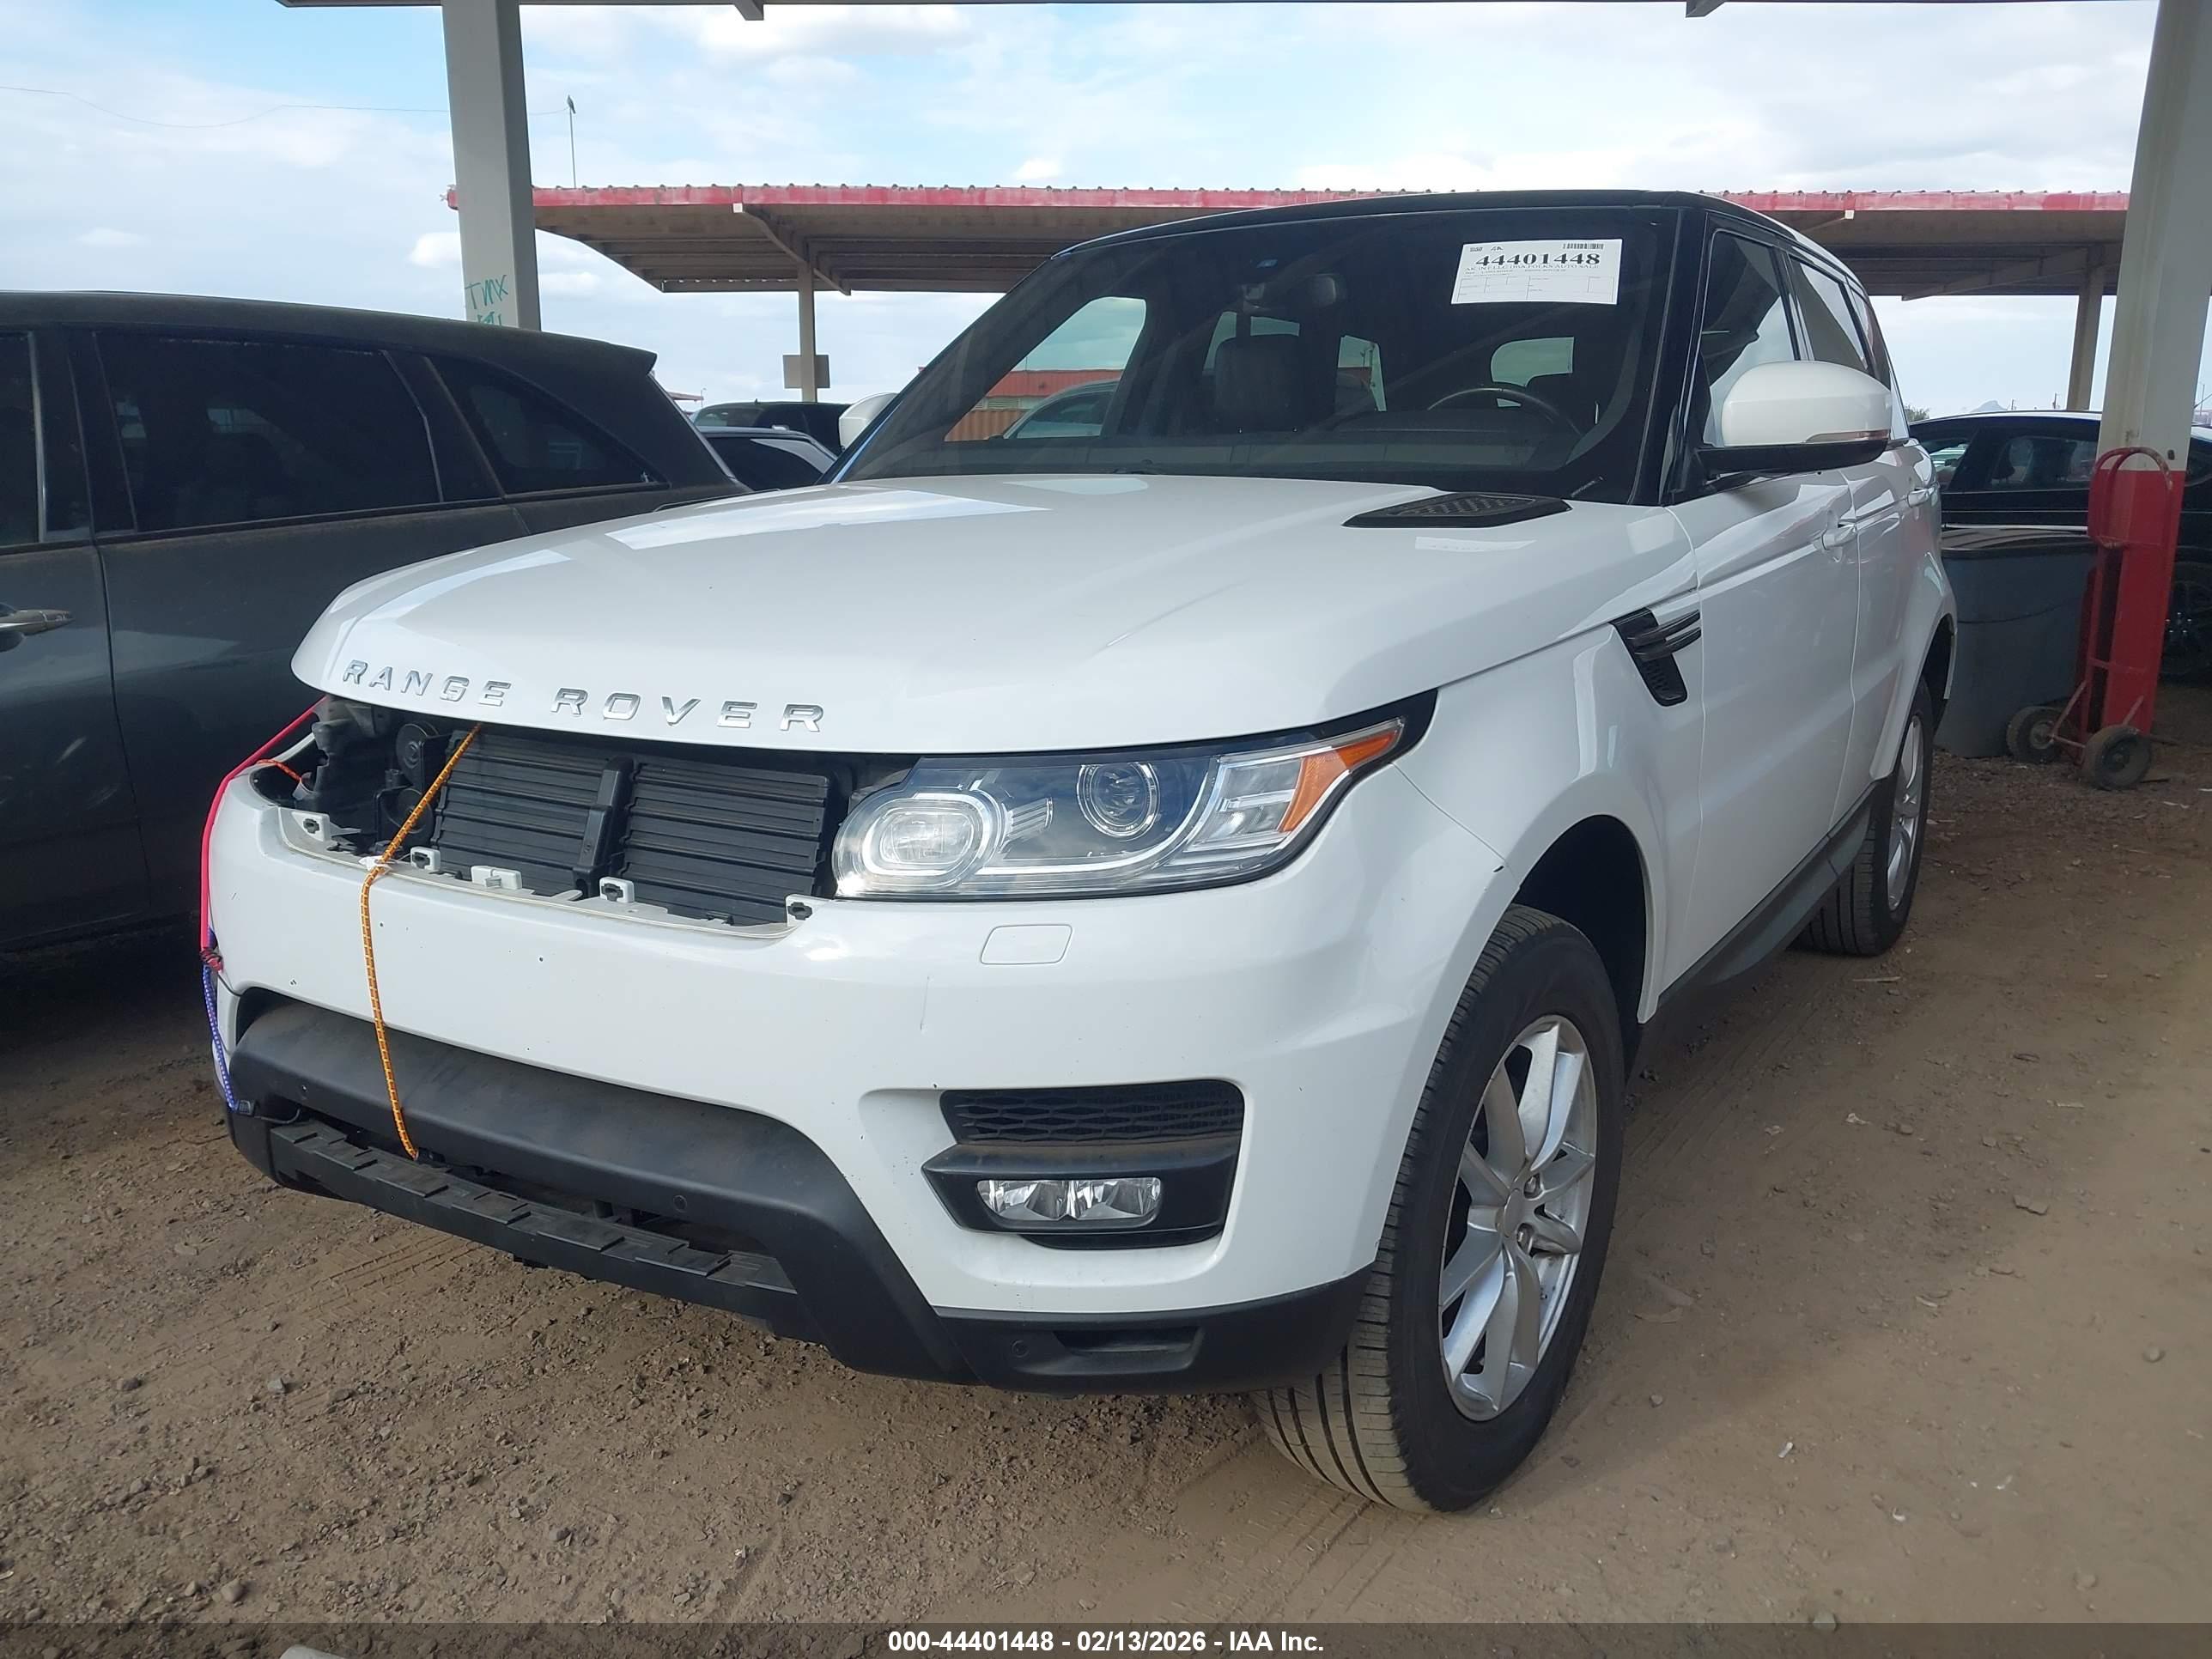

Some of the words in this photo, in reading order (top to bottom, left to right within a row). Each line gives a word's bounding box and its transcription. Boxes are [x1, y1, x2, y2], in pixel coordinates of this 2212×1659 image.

[1475, 252, 1601, 266] 44401448
[343, 659, 511, 708] RANGE
[550, 687, 824, 732] ROVER
